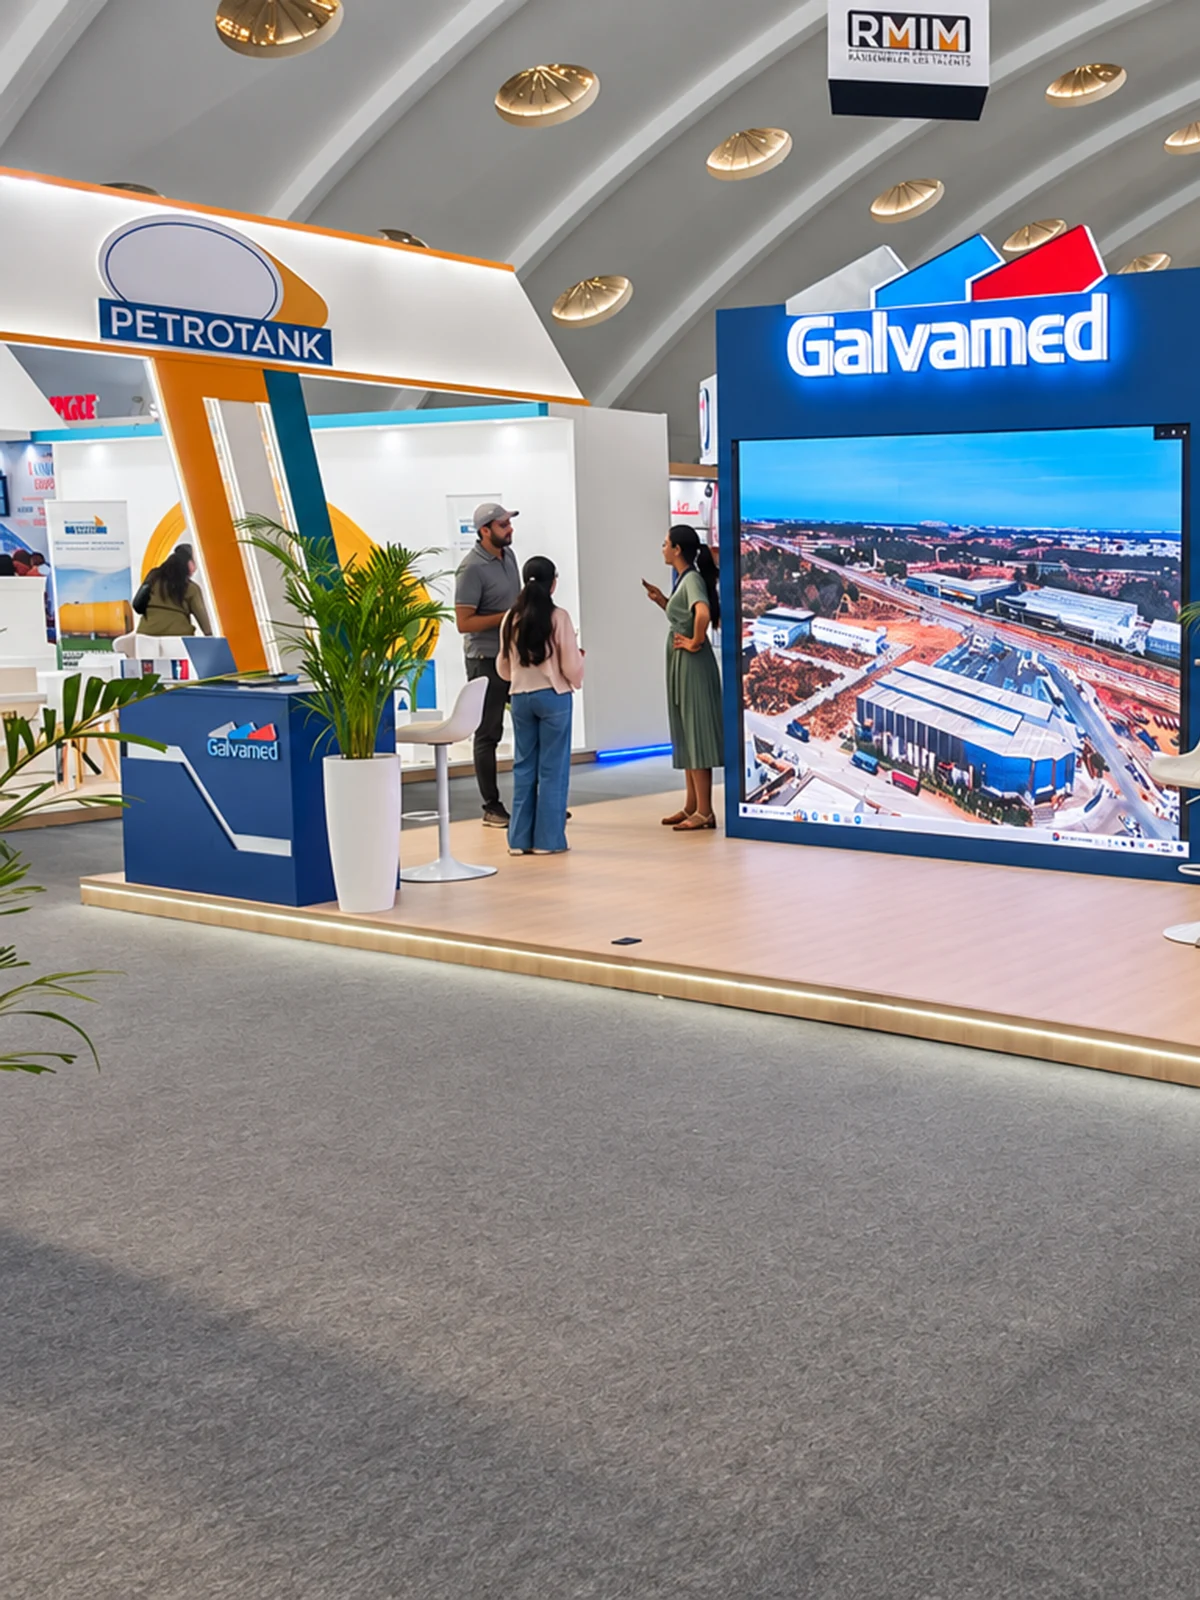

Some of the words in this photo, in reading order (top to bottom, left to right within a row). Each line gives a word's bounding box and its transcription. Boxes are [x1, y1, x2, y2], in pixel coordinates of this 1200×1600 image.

[851, 13, 967, 51] RMIM
[110, 305, 324, 361] PETROTANK
[786, 293, 1108, 377] Galvamed
[207, 738, 279, 761] Galvamed
